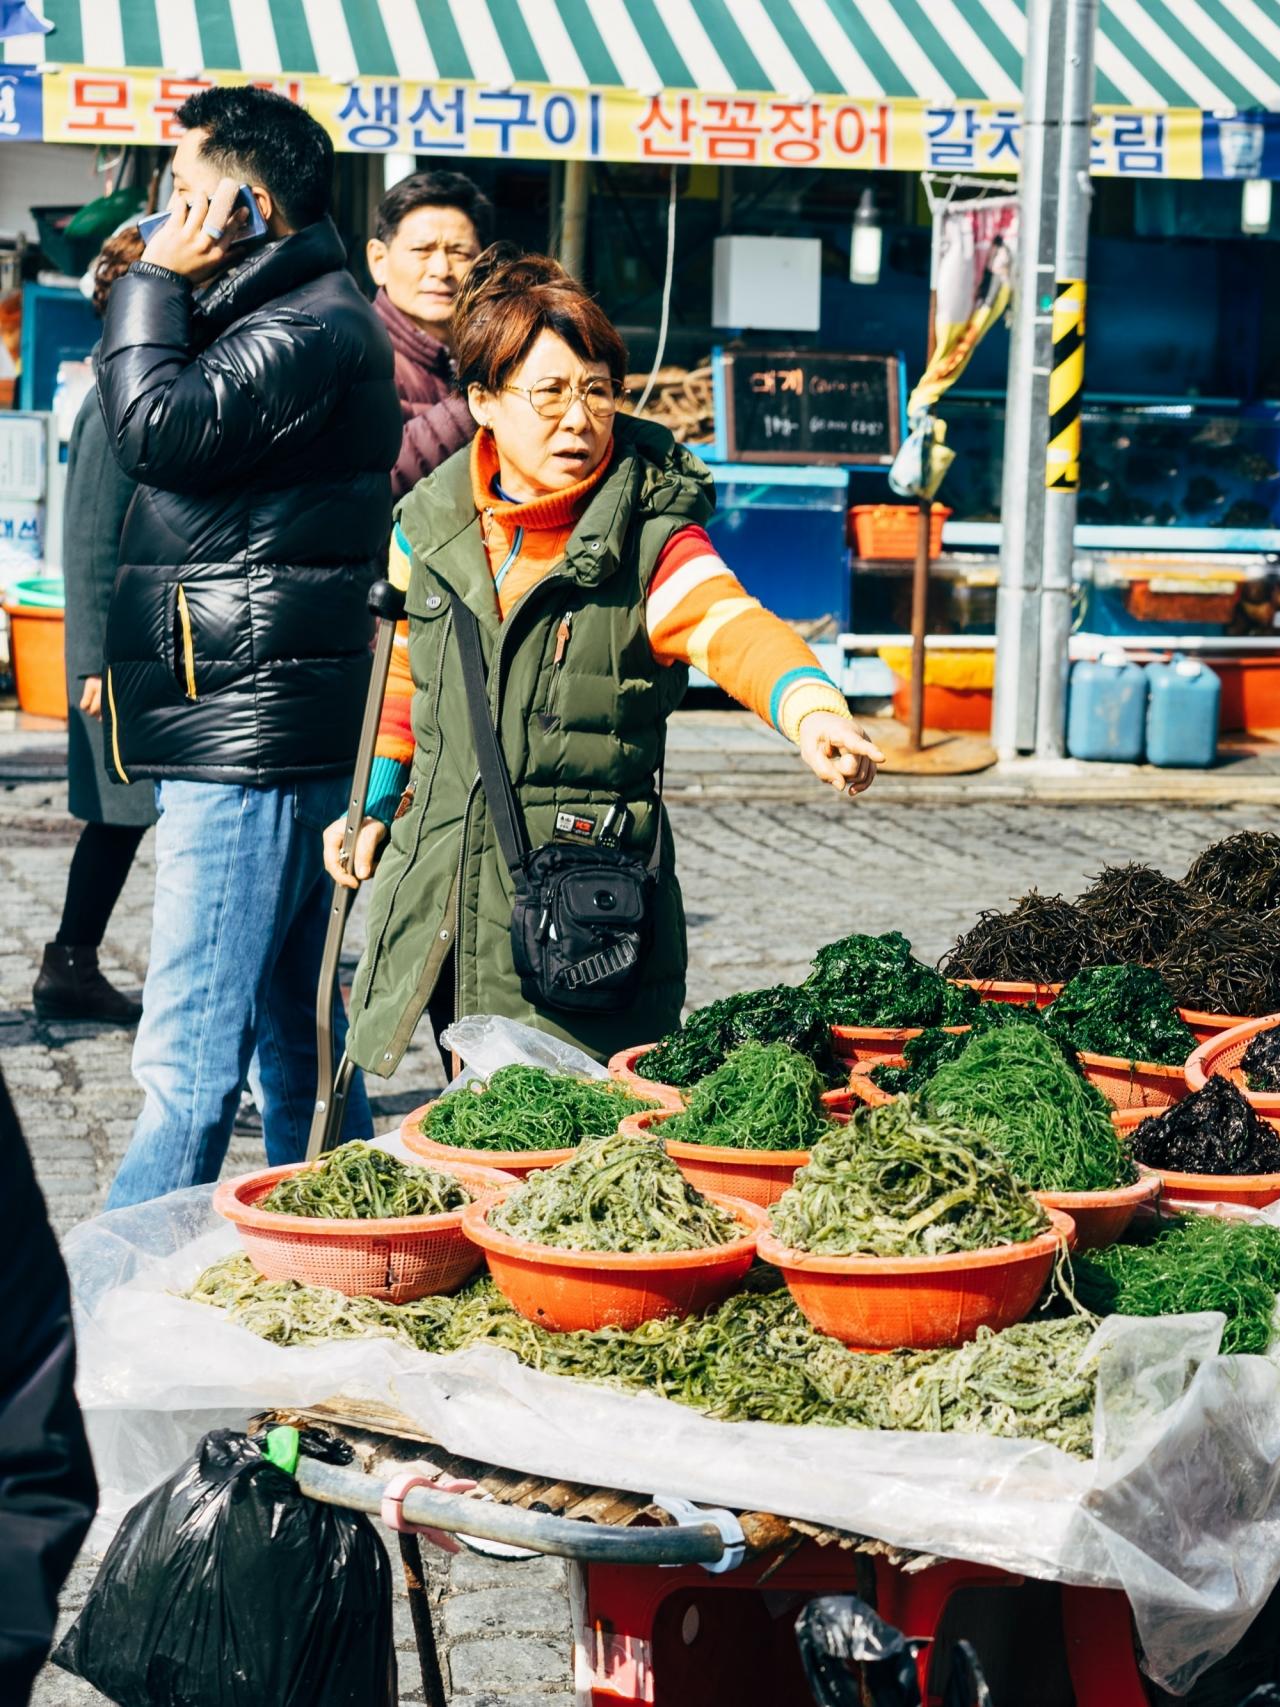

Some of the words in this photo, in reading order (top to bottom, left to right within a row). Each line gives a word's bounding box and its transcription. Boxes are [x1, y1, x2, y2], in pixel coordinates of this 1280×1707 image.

[339, 84, 602, 155] 생선구이
[638, 95, 890, 167] 산꼼장어
[926, 109, 1165, 173] 갈치림
